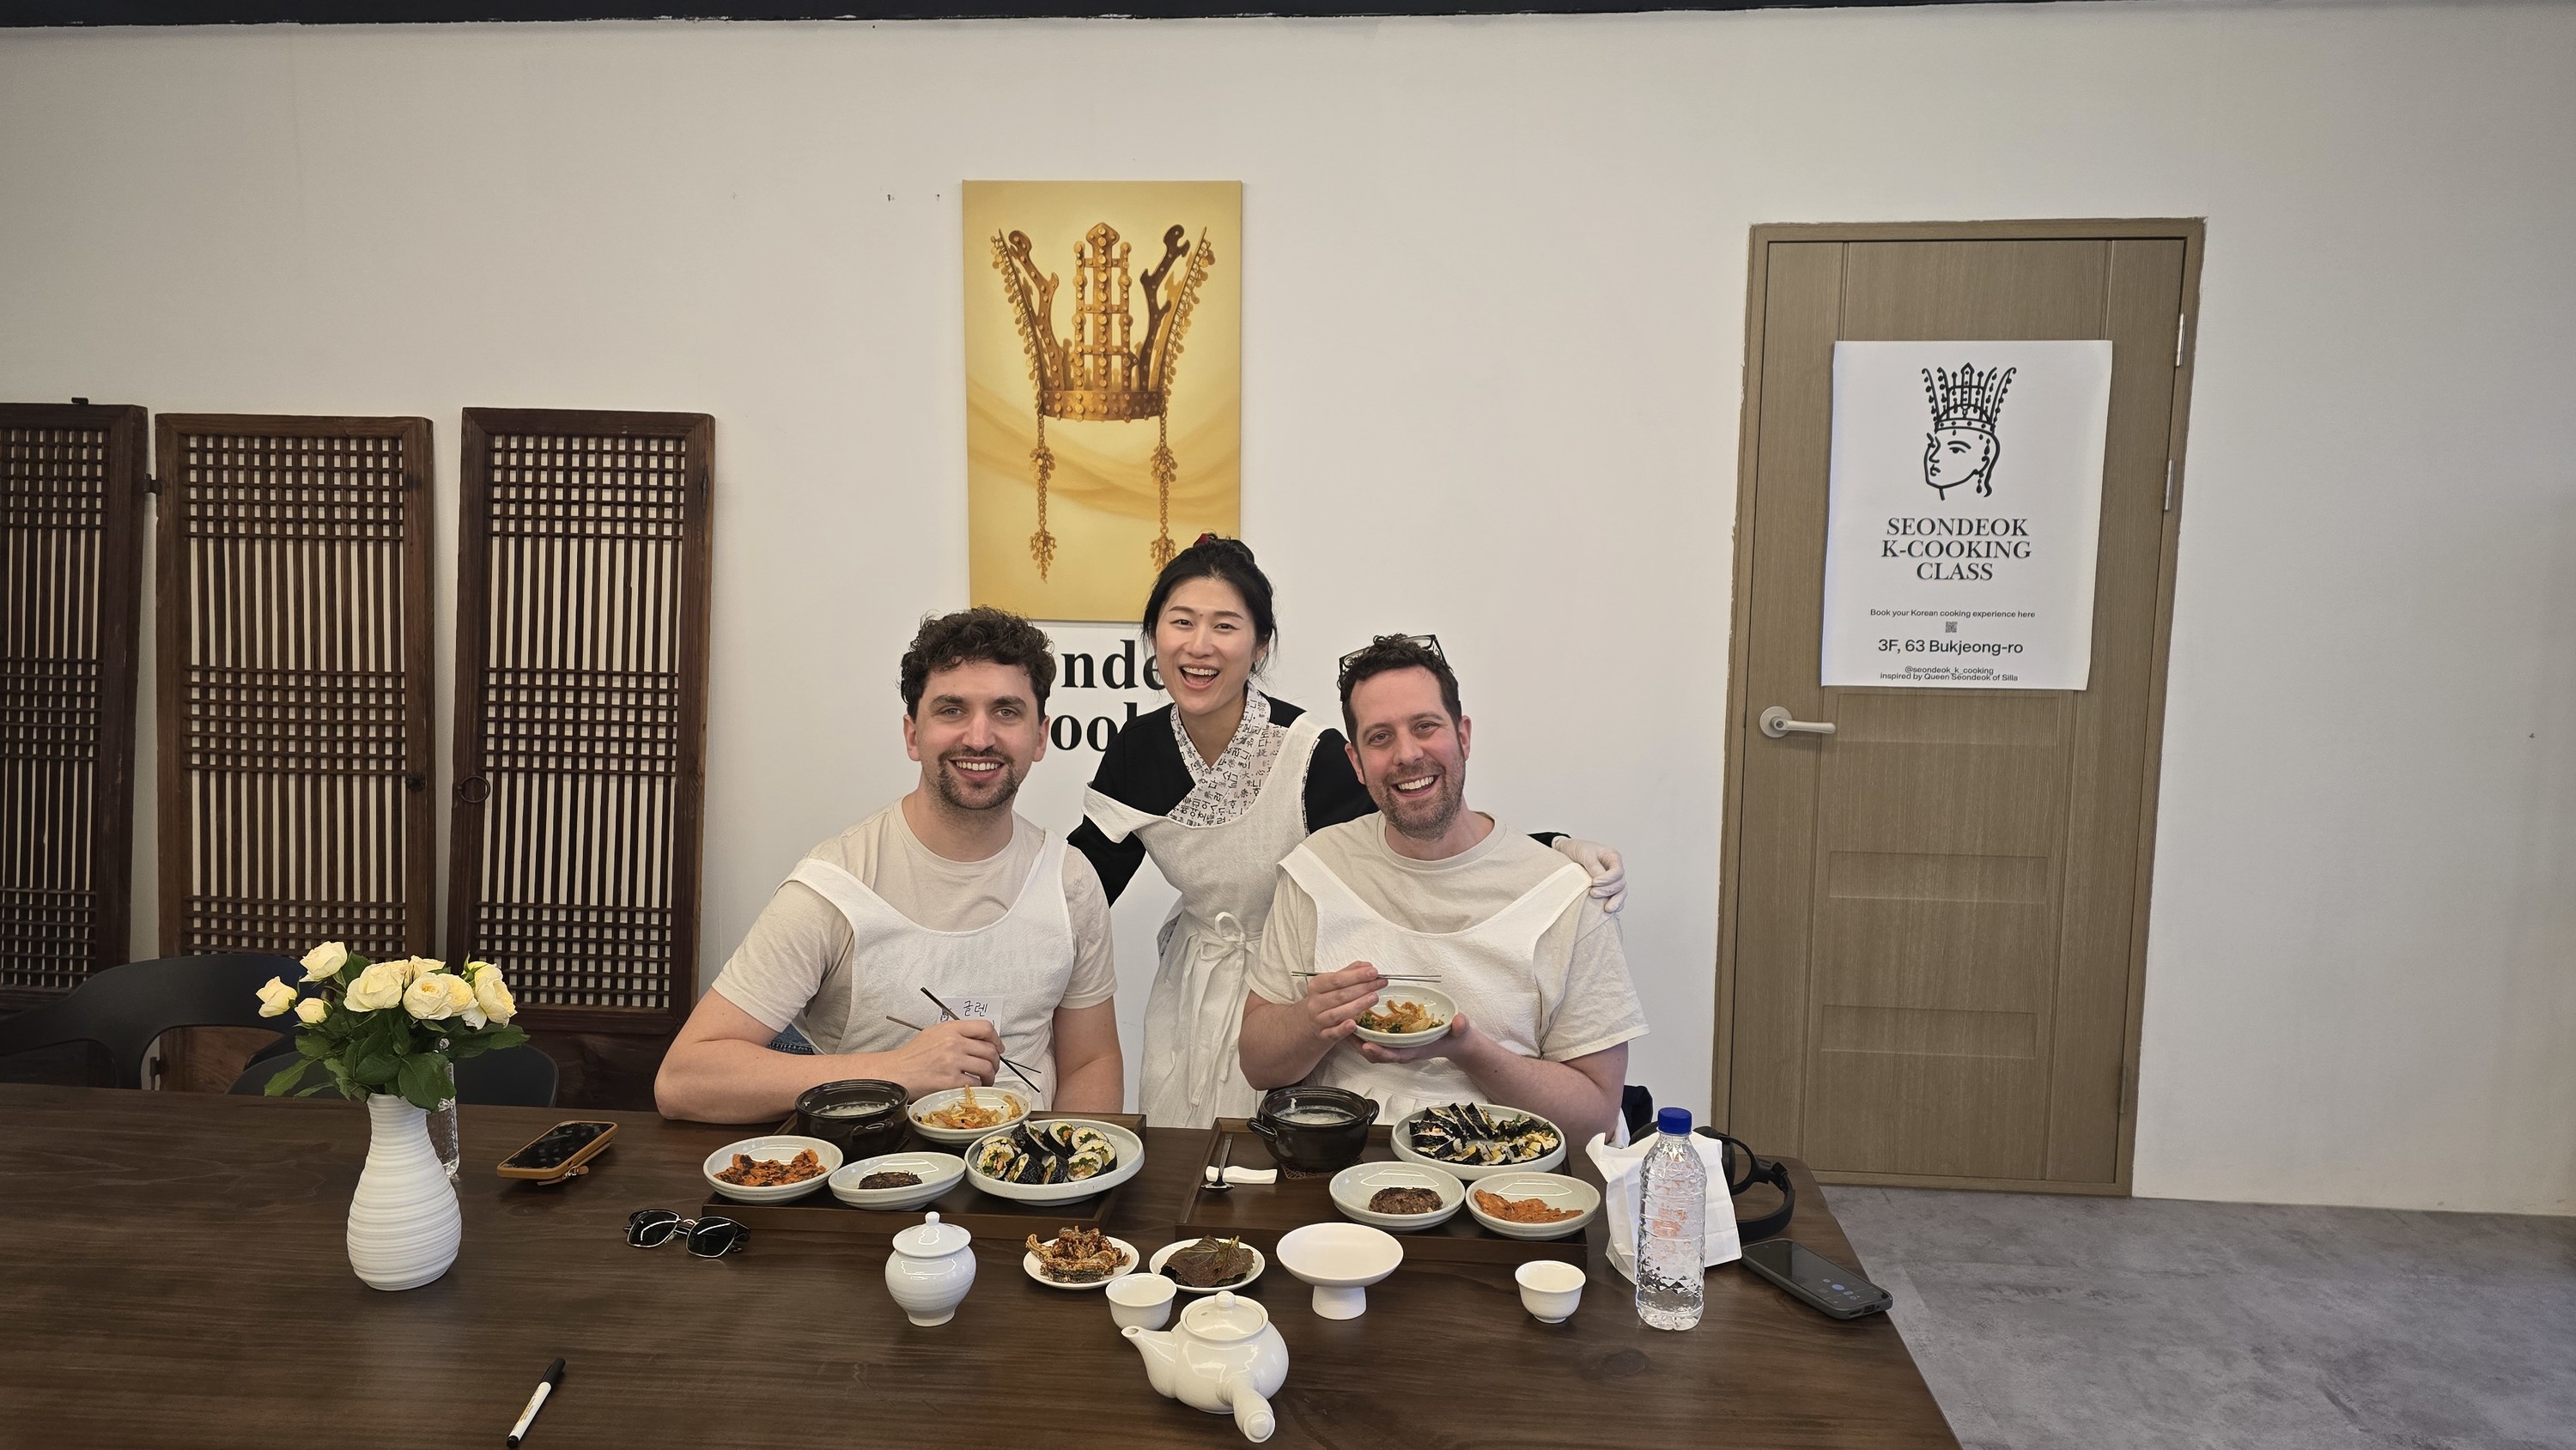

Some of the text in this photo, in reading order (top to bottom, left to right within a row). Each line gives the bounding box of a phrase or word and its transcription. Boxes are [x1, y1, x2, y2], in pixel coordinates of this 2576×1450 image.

[1886, 517, 2030, 537] SEONDEOK
[1881, 539, 2032, 559] K-COOKING
[1917, 561, 1994, 581] CLASS
[1940, 610, 1971, 619] cooking
[1972, 610, 2016, 619] experience
[1878, 639, 2024, 657] 3F, 63 Bukjeong-ro
[1905, 665, 1995, 675] @seondeok_k_cooking
[1912, 673, 1923, 682] by
[1923, 673, 1950, 682] Queen
[1951, 673, 1991, 682] Seondeok
[2002, 674, 2019, 683] Silla
